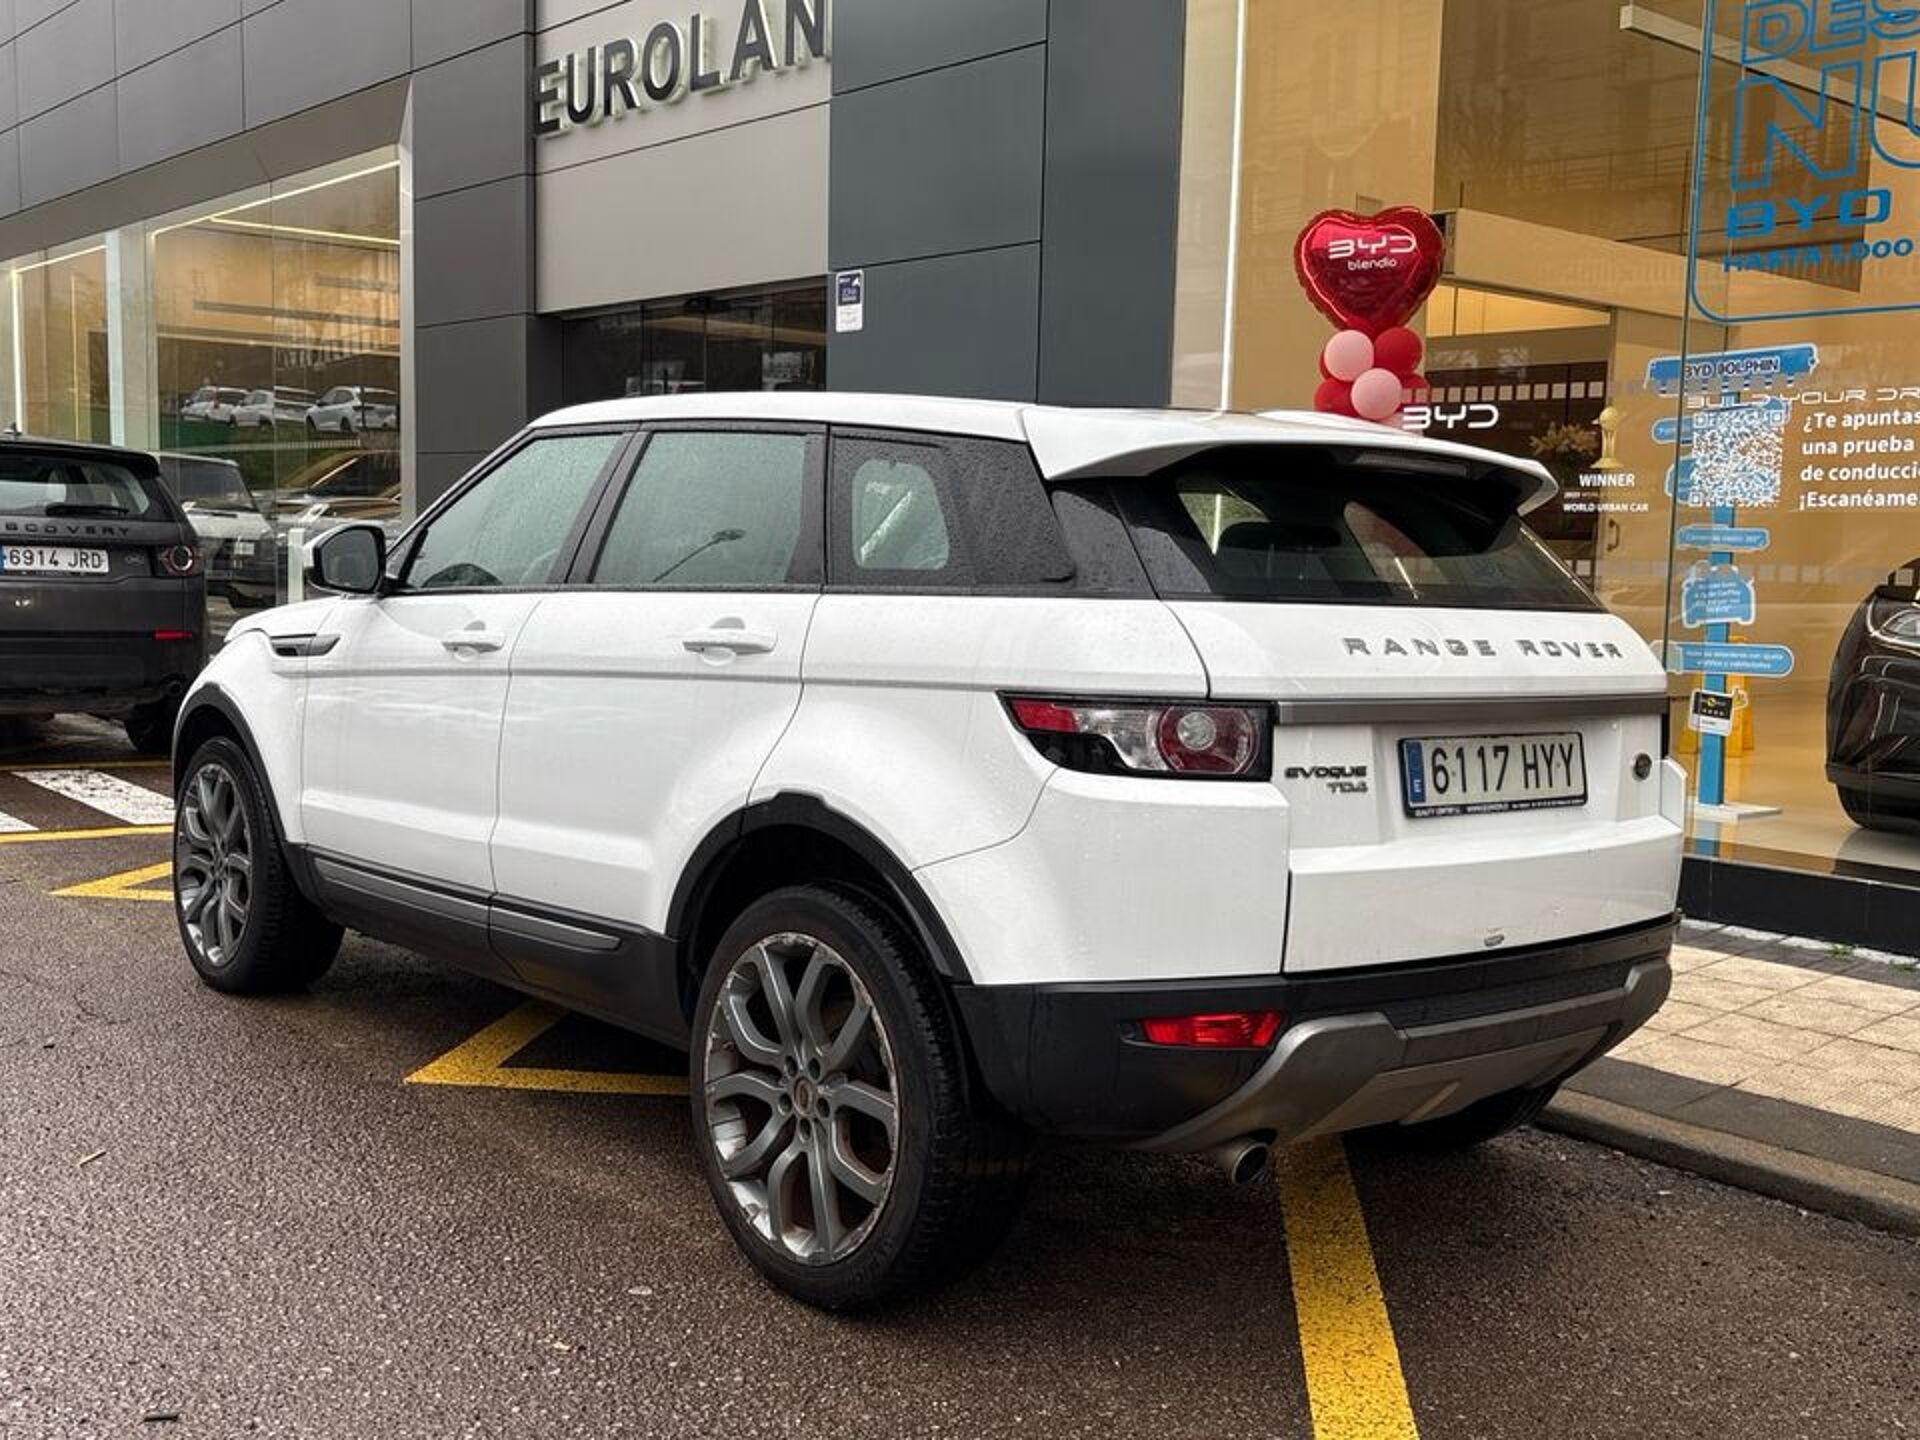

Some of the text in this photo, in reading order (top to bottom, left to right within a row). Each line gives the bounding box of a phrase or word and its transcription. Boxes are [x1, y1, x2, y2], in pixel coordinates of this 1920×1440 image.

[1727, 189, 1892, 238] BYD
[1328, 235, 1417, 259] BYD
[1347, 257, 1397, 271] blendio
[1717, 356, 1780, 375] DOLPHIN
[1402, 404, 1499, 429] BYD
[1803, 412, 1837, 432] ¿Te
[1802, 435, 1915, 458] una prueba
[1579, 473, 1635, 487] WINNER
[1801, 462, 1920, 481] de conducci
[1800, 488, 1920, 511] ¡Escanéame
[9, 549, 60, 567] 6914
[68, 551, 103, 569] JRD
[1343, 637, 1624, 659] RANGE ROVER
[1285, 766, 1367, 779] EVOQUE
[1431, 743, 1574, 794] 6117 HYY
